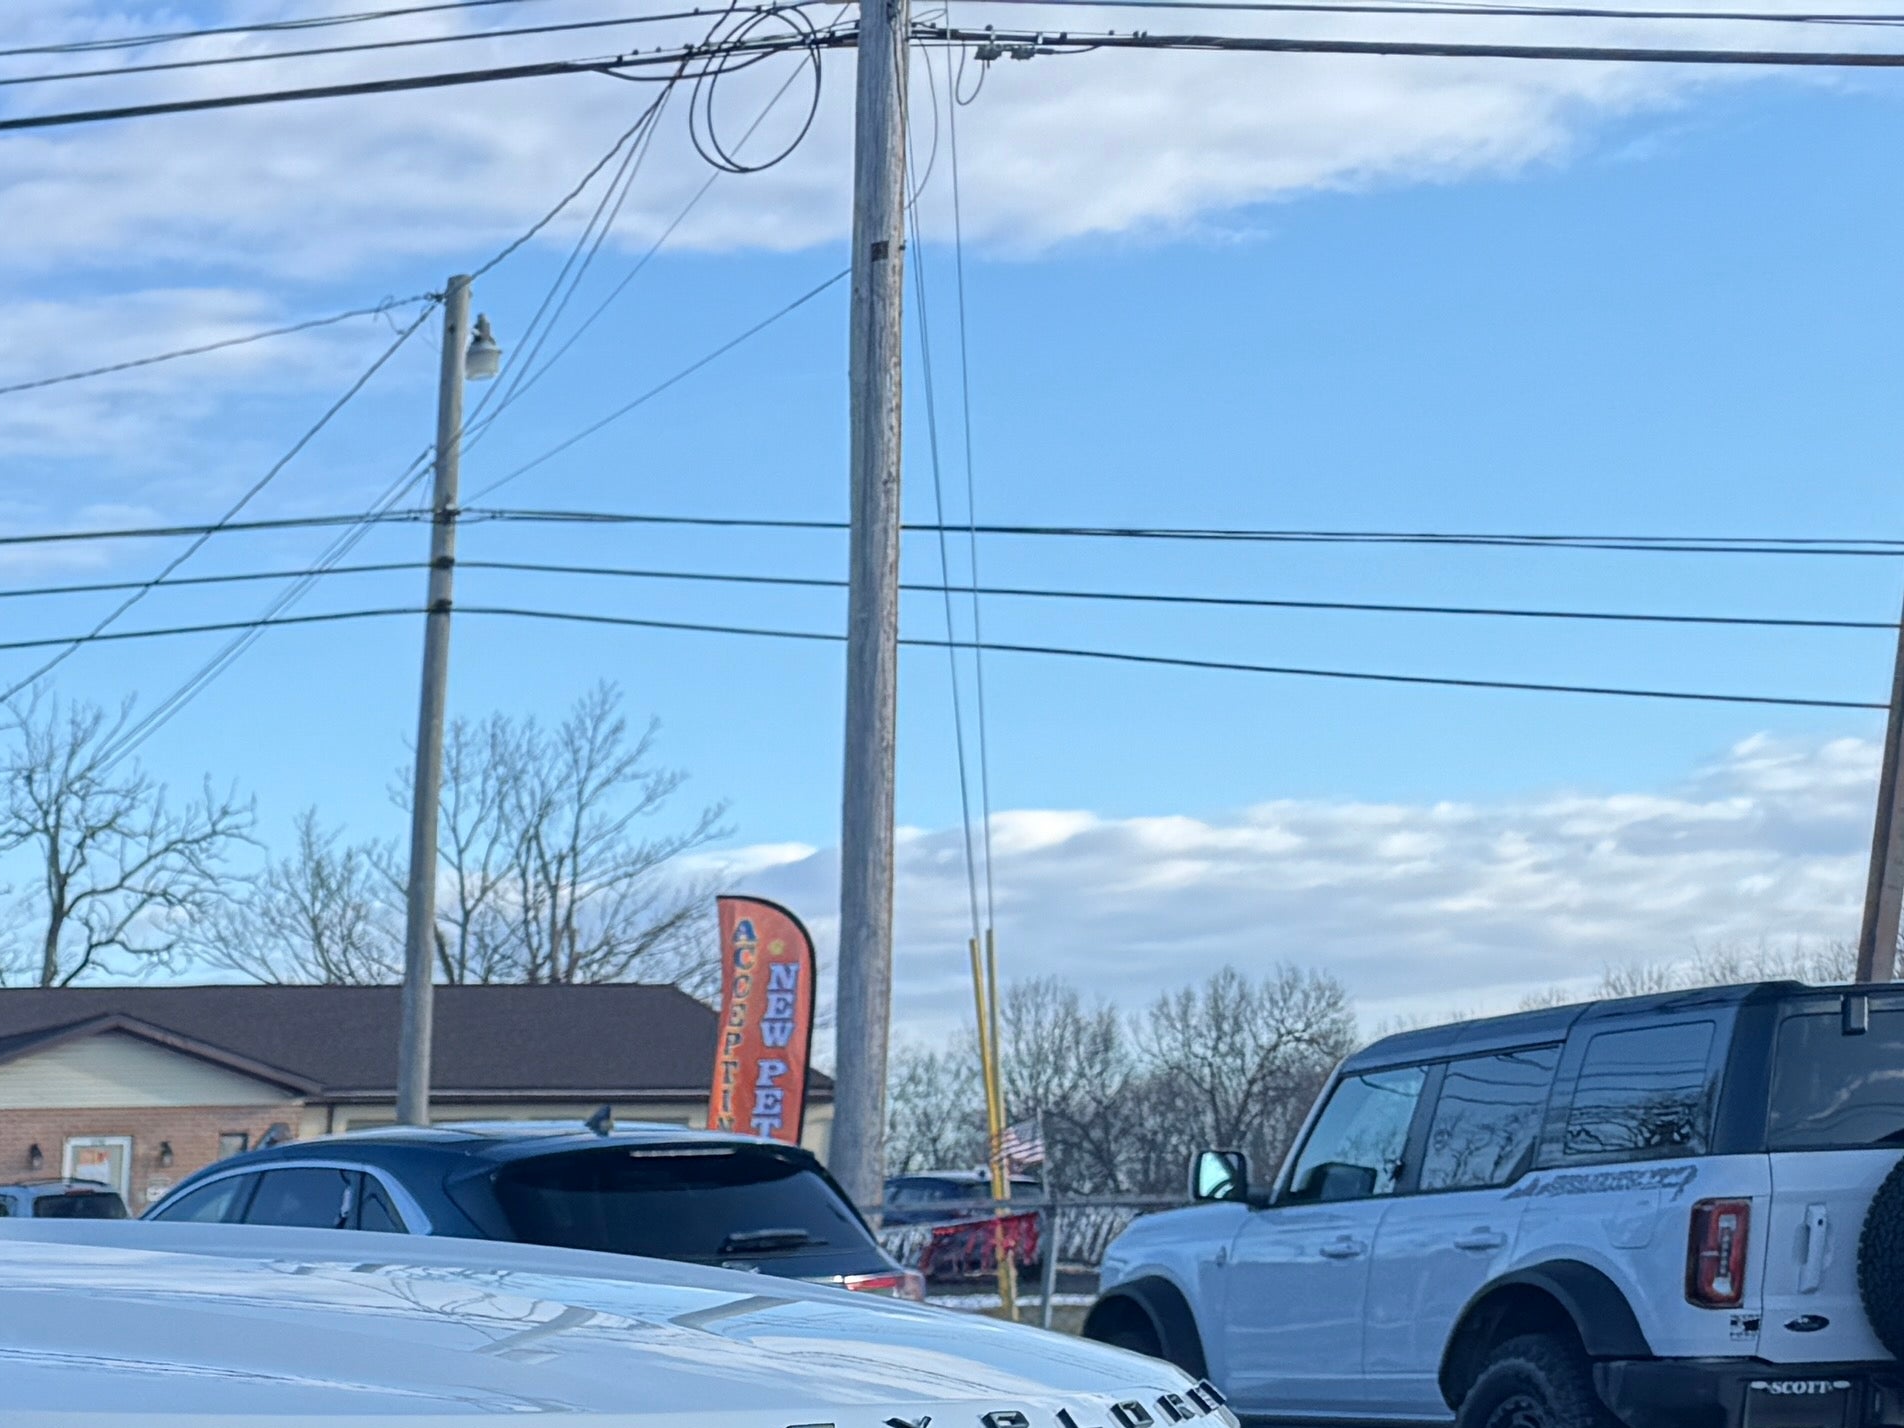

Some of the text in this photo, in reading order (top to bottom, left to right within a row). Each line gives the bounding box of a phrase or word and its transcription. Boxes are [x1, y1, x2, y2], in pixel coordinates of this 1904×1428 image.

[717, 918, 758, 1132] ACCEPTIN
[750, 962, 800, 1139] NEW PET
[1771, 1381, 1826, 1394] SCOTT
